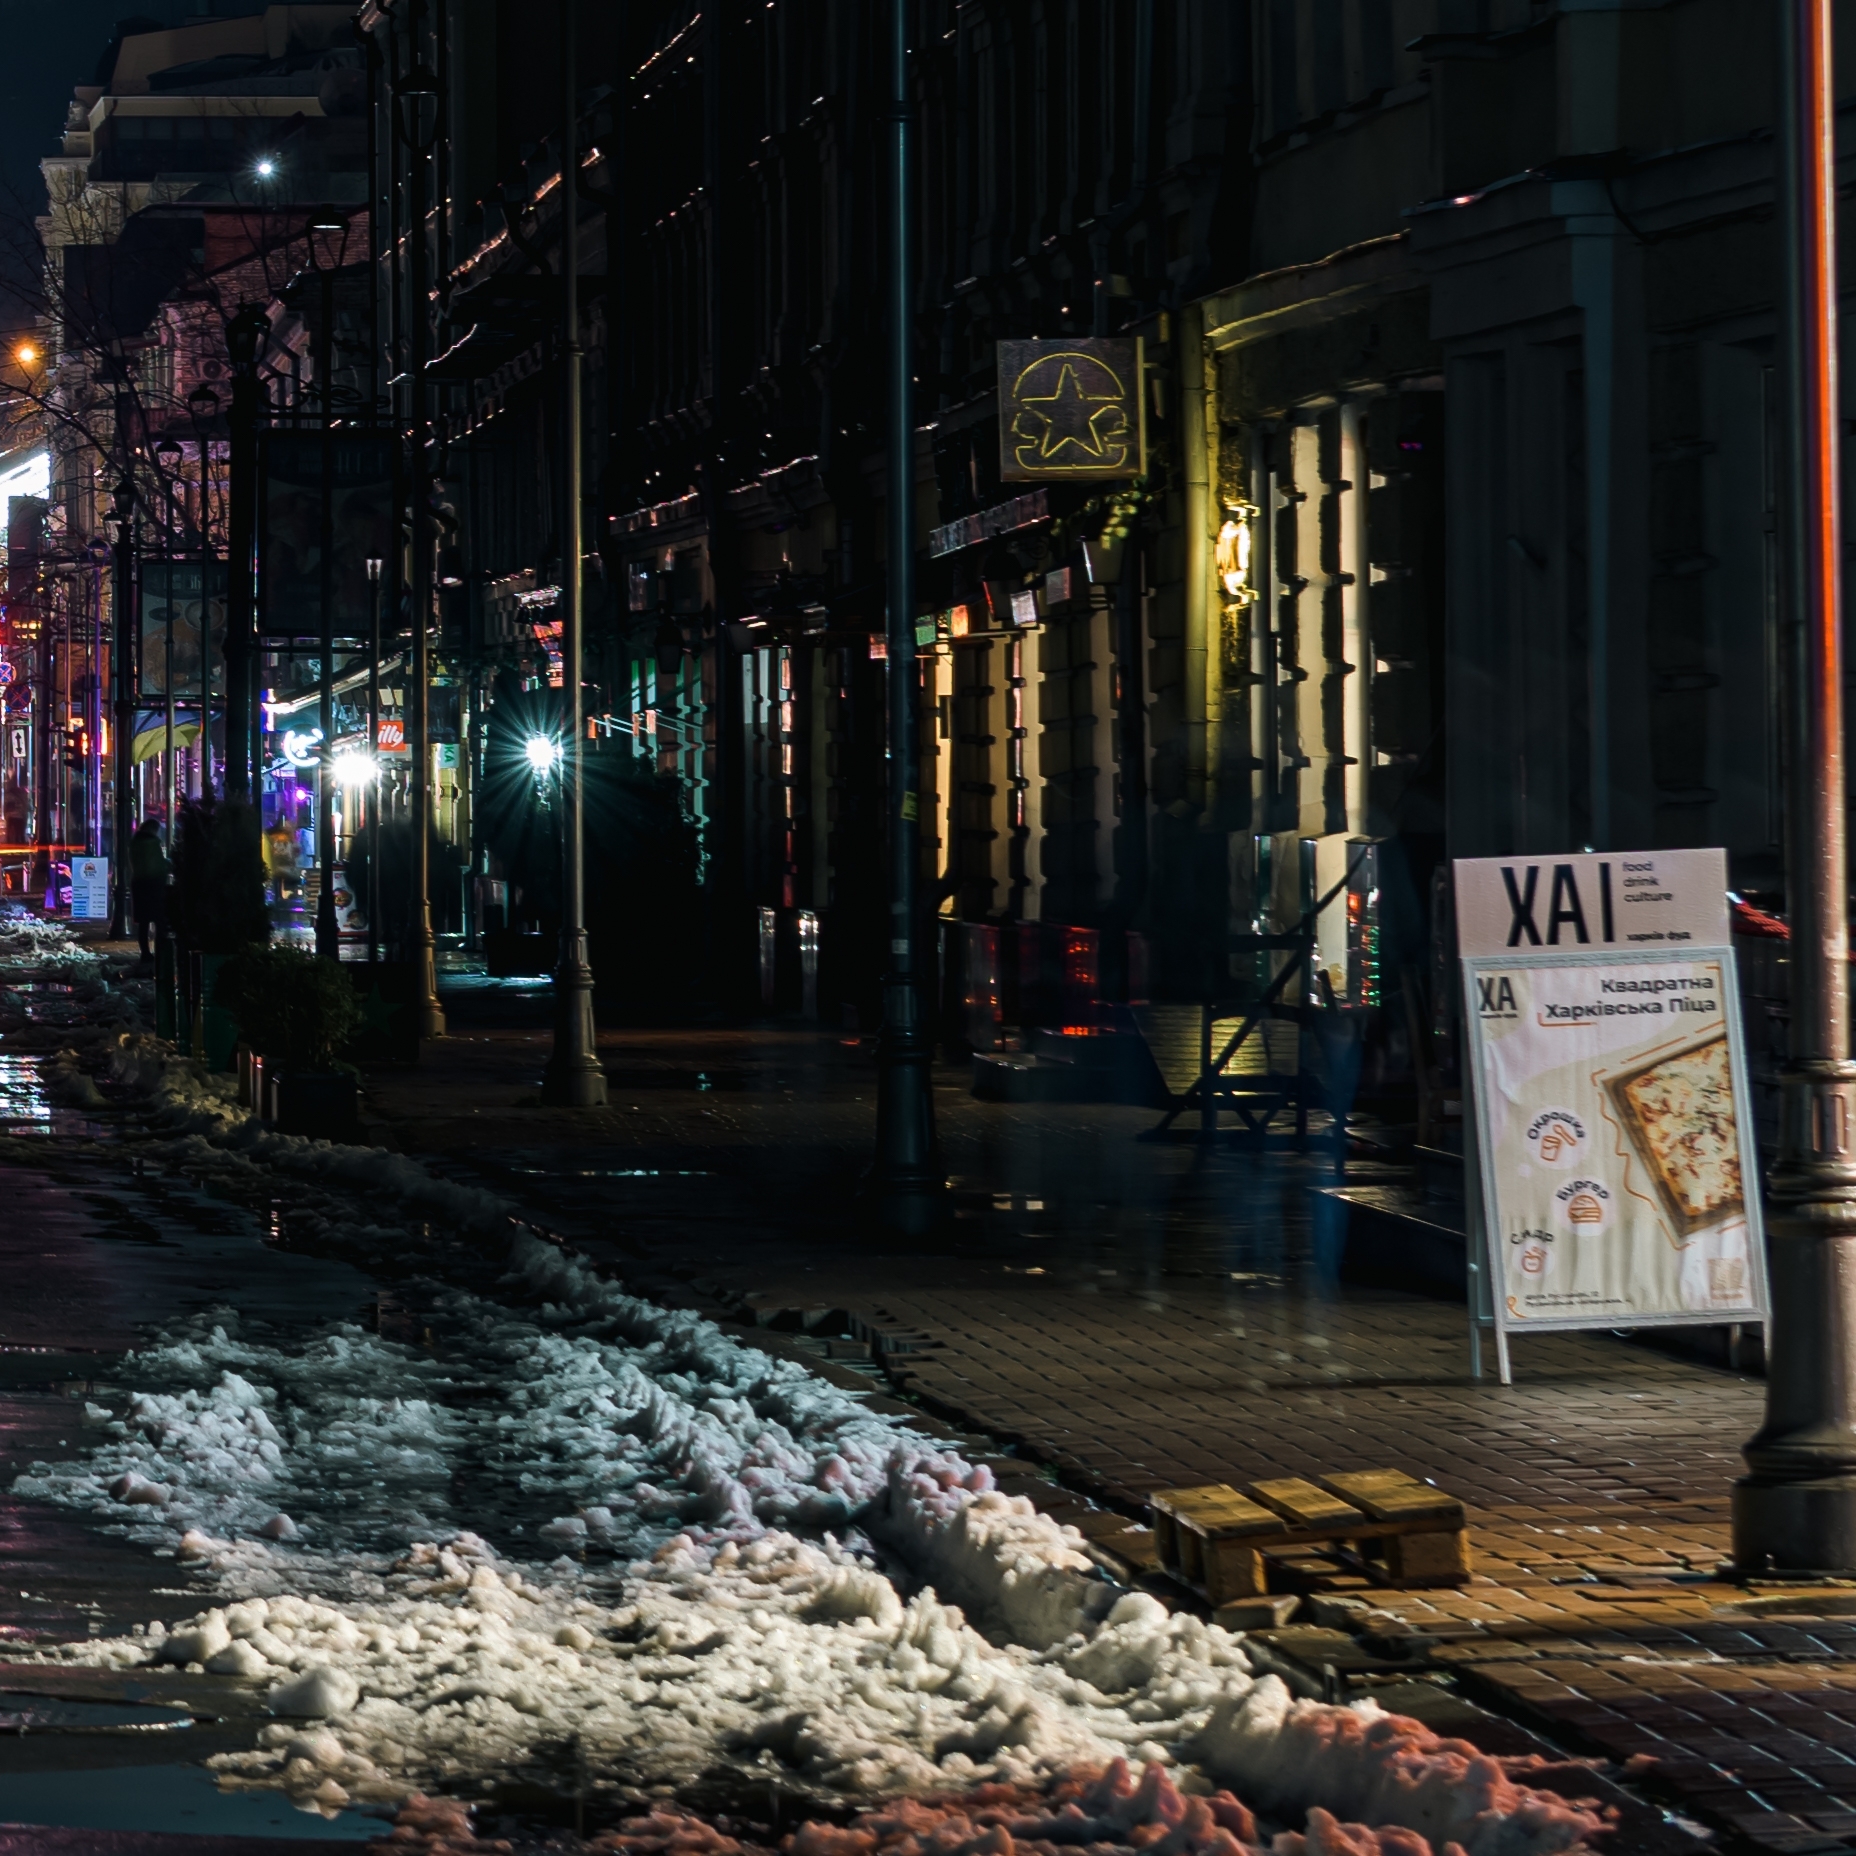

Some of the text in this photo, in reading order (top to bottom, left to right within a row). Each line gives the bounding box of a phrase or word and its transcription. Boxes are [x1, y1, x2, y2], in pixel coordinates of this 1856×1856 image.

[377, 724, 403, 748] illy
[1622, 860, 1654, 872] food
[1623, 876, 1659, 888] drink
[1623, 891, 1674, 903] culture
[1476, 976, 1518, 1012] ХА
[1600, 977, 1715, 996] Квадратна
[1545, 997, 1717, 1021] Харківська Піца
[1556, 1180, 1610, 1201] Бургер
